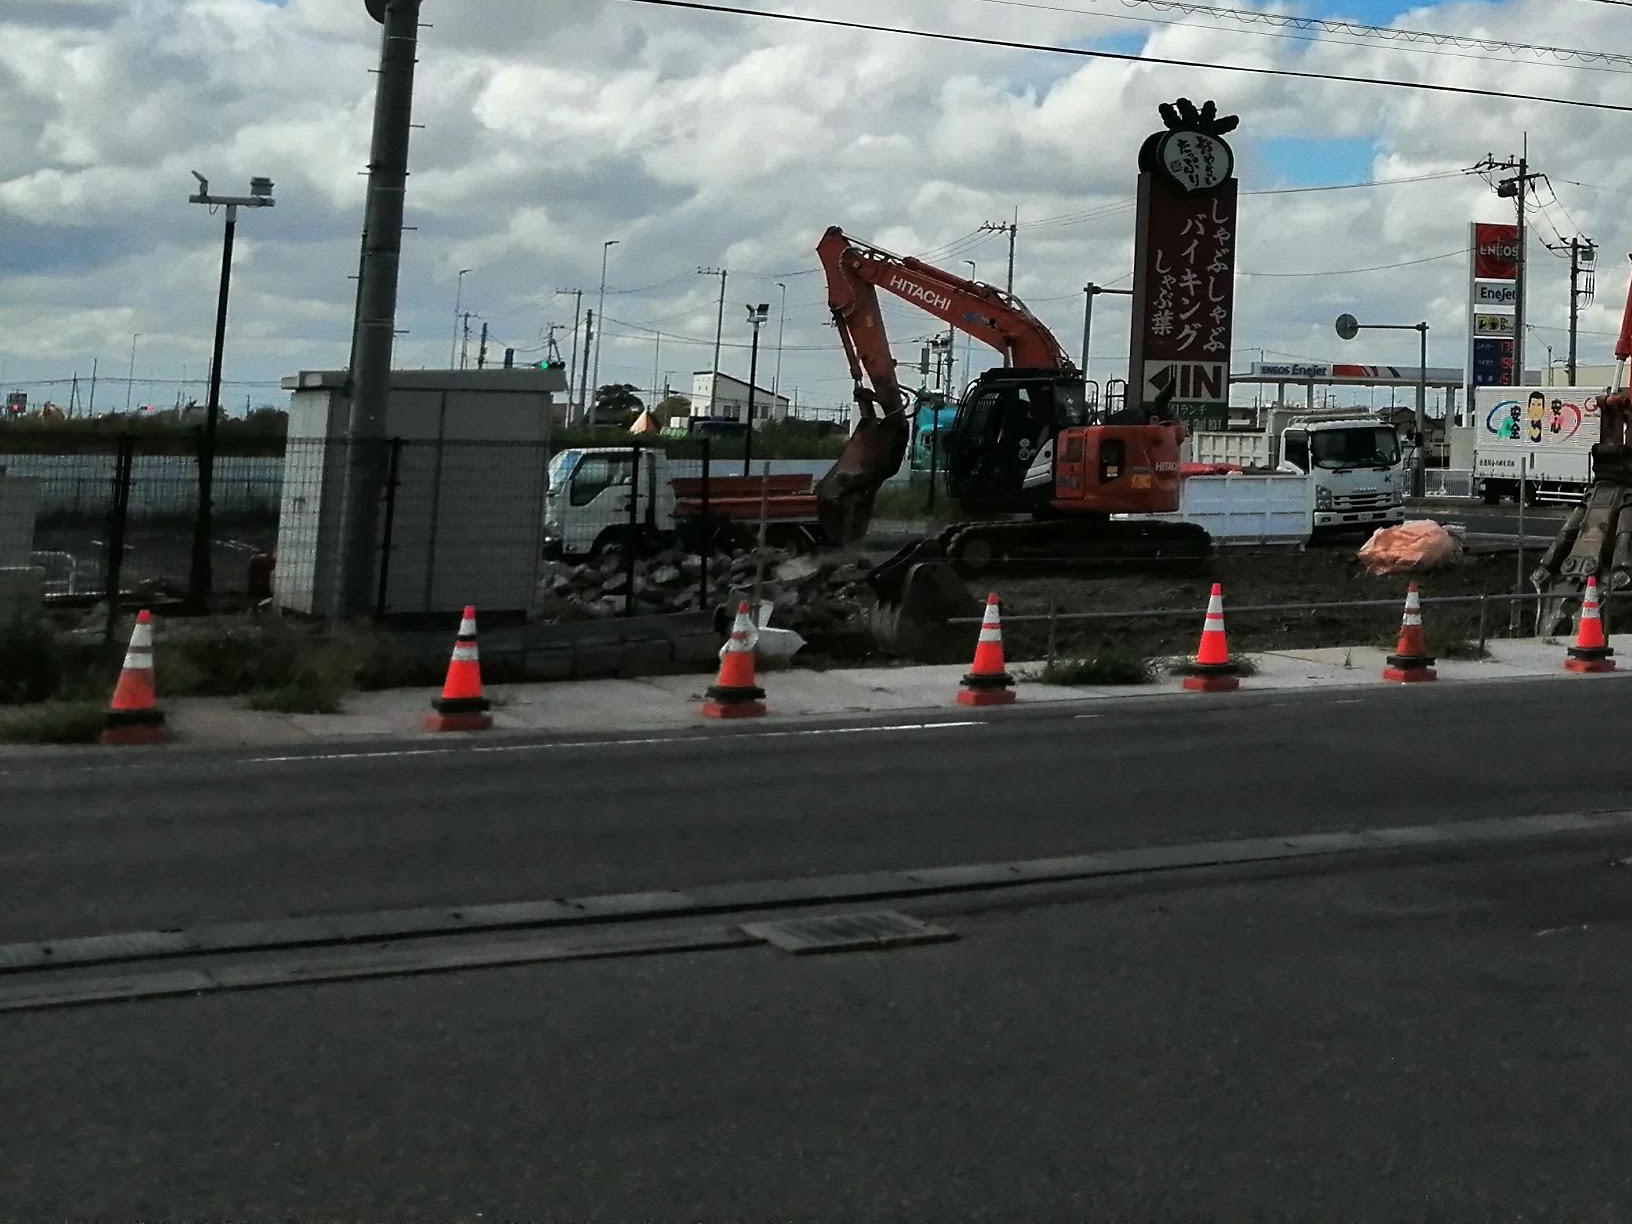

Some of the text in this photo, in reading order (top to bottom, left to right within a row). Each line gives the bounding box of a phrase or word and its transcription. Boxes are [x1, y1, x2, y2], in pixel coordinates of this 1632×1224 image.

[889, 274, 952, 312] HITACHI
[1151, 249, 1176, 336] しゃぶ葉
[1176, 213, 1207, 352] バイキング
[1203, 197, 1231, 353] しゃぶしゃぶ
[1180, 365, 1222, 399] IN
[1509, 405, 1521, 439] 安全
[1550, 398, 1562, 434] 安心
